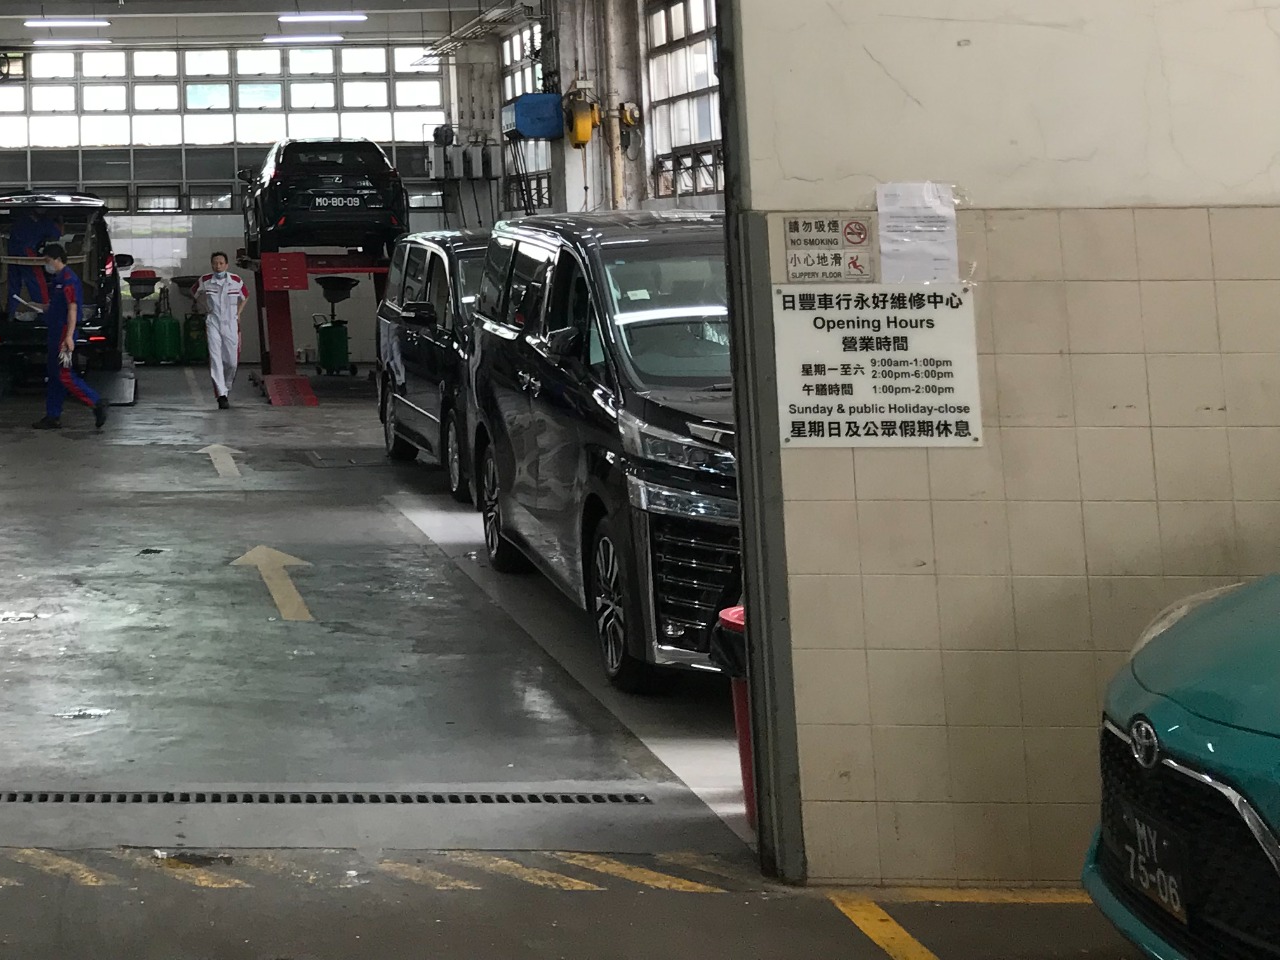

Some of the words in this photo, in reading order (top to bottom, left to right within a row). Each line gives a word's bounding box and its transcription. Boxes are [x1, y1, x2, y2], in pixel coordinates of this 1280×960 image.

[788, 220, 840, 233] 請勿吸煙
[790, 238, 802, 246] NO
[803, 238, 839, 246] SMOKING
[790, 253, 842, 267] 小心地滑
[822, 271, 842, 279] FLOOR
[782, 292, 963, 311] 日豐車行永好維修中心
[813, 316, 881, 332] Opening
[886, 316, 935, 329] Hours
[841, 336, 909, 352] 營業時間
[801, 363, 865, 376] 星期一至六
[870, 358, 953, 368] 9:00am-1:00pm
[871, 370, 954, 380] 2:00pm-6:00pm
[802, 383, 854, 396] 午膳時間
[872, 385, 955, 395] 1:00pm-2:00pm
[788, 404, 833, 416] Sunday
[837, 404, 845, 414] &
[849, 403, 885, 416] public
[888, 403, 970, 416] Holiday-close
[790, 420, 972, 438] 星期日及公眾假期休息
[1124, 845, 1182, 913] 75-06
